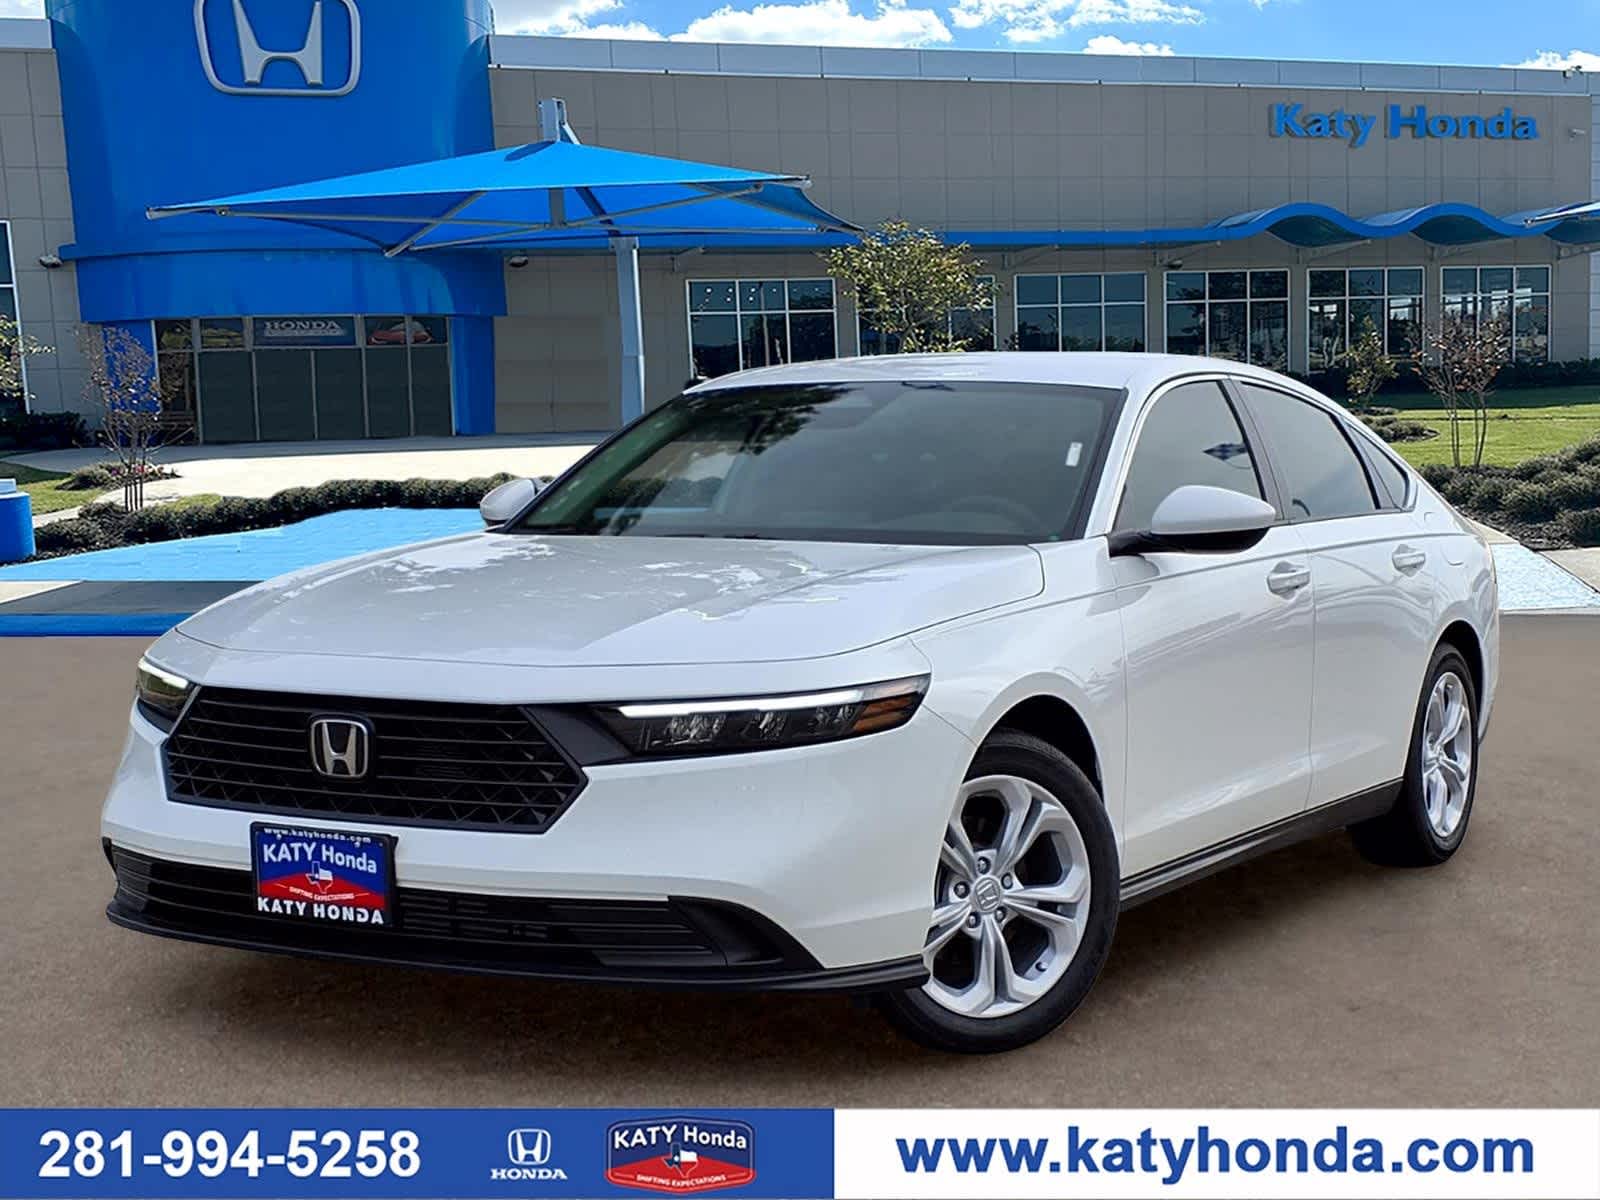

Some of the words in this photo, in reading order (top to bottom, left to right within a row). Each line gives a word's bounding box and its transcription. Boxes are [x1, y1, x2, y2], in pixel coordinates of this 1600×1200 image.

[1269, 102, 1376, 148] Katy
[1384, 103, 1539, 140] Honda
[264, 320, 341, 329] HONDA
[263, 827, 372, 844] www.katyhonda.com
[263, 842, 316, 863] KATY
[321, 844, 377, 874] Honda
[257, 897, 306, 917] KATY
[313, 904, 384, 925] HONDA
